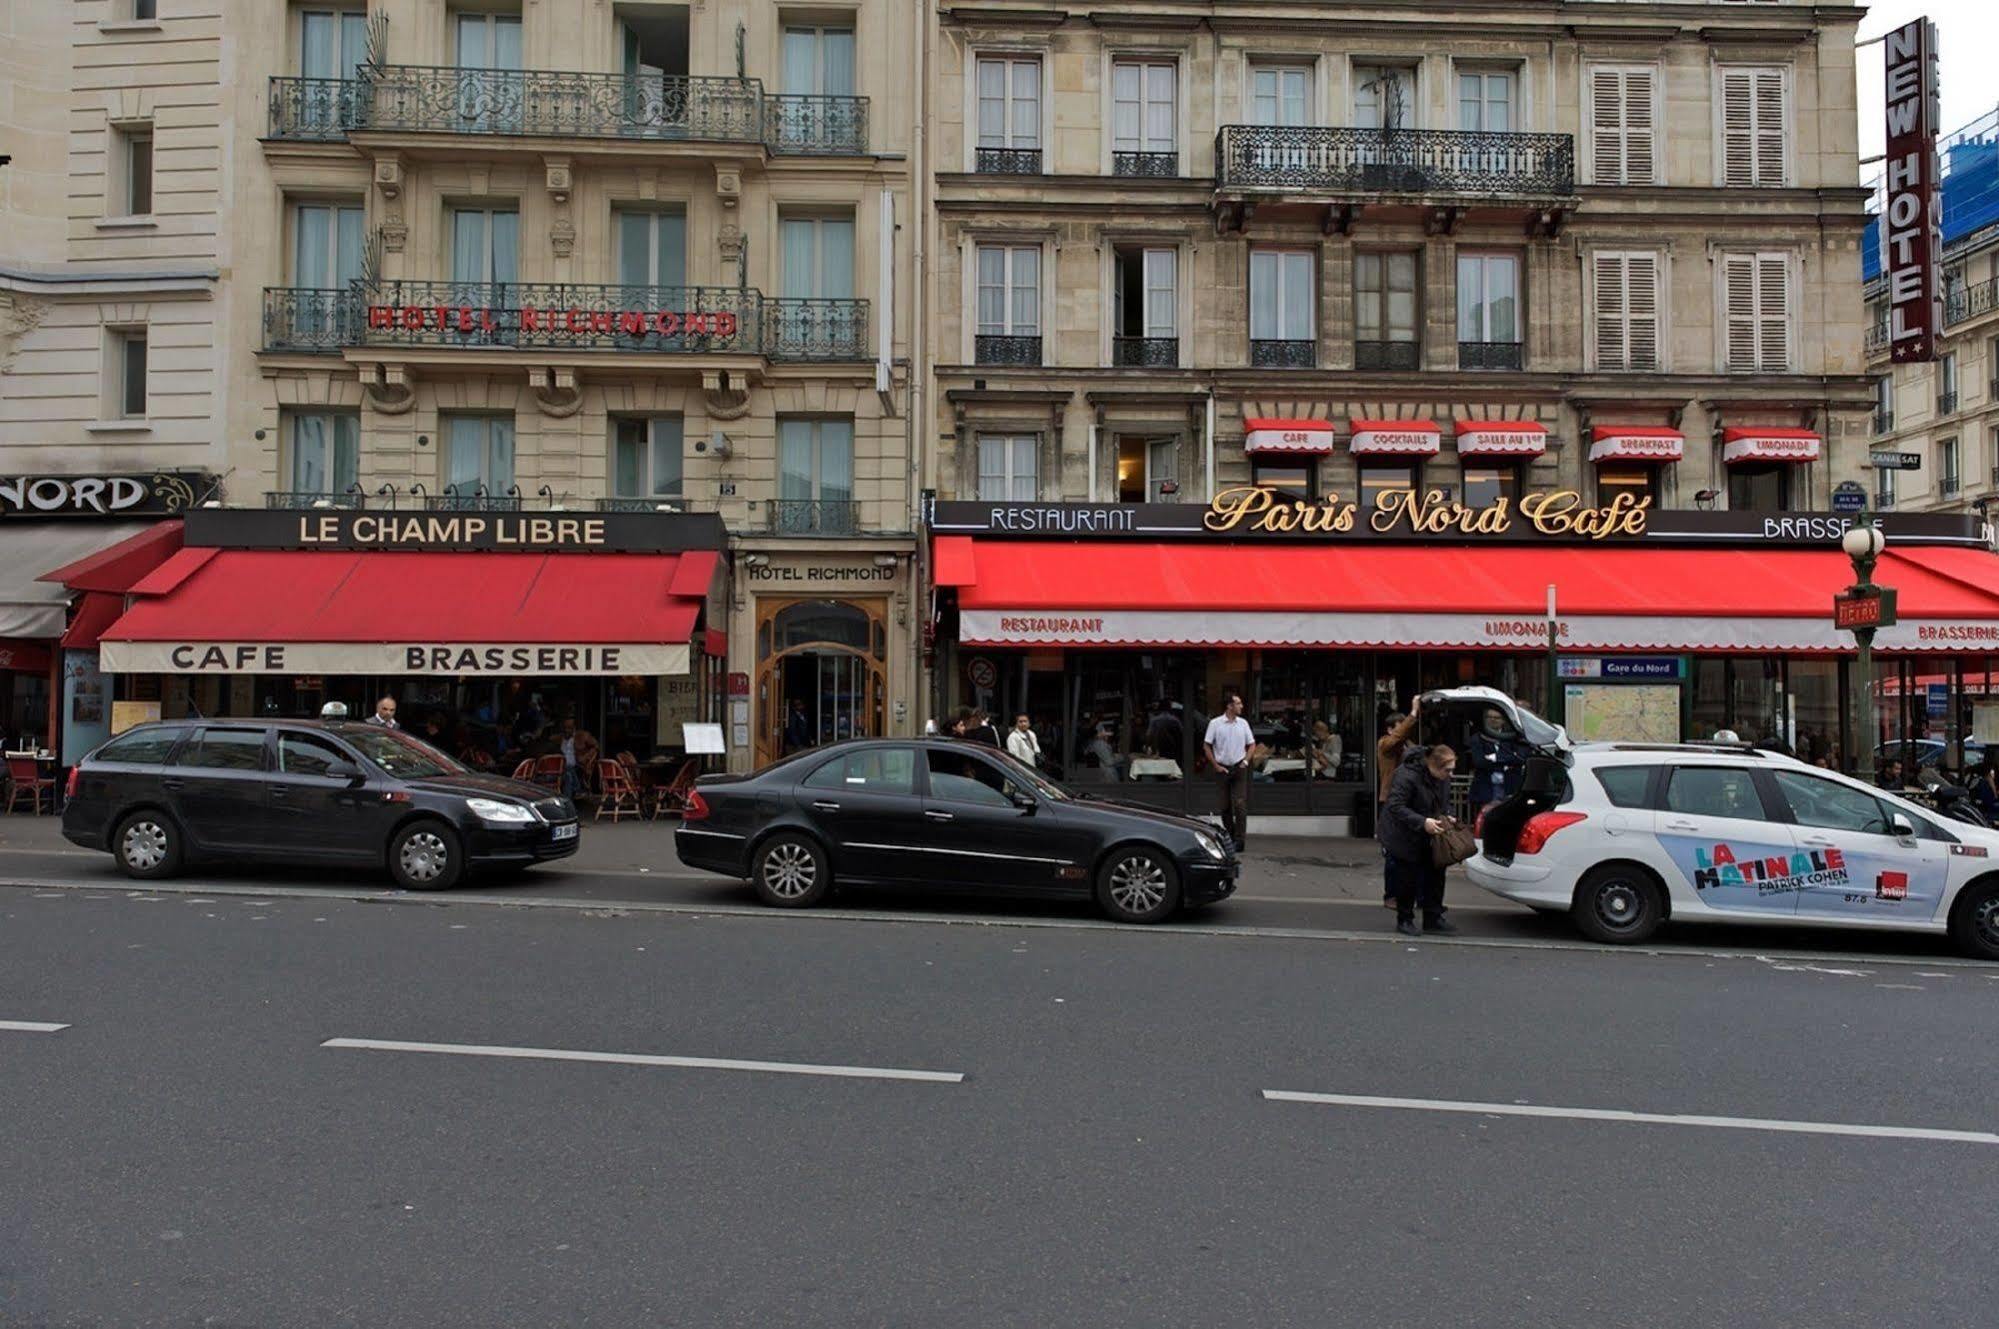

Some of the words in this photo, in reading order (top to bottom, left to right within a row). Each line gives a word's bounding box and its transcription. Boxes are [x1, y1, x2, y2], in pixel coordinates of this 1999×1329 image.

[1887, 24, 1918, 138] NEW
[1889, 152, 1922, 342] HOTEL
[369, 306, 497, 331] HOTEL
[521, 309, 737, 336] RICHMOND
[0, 477, 145, 514] NORD
[991, 508, 1135, 531] RESTAURANT
[1204, 487, 1356, 532] Paris
[1371, 489, 1511, 533] Nord
[1520, 491, 1652, 539] Café
[300, 517, 339, 542] LE
[352, 517, 486, 542] CHAMP
[496, 519, 606, 544] LIBRE
[808, 567, 895, 580] RICHMOND
[1001, 618, 1103, 633] RESTAURANT
[172, 646, 285, 669] CAFE
[407, 647, 620, 671] BRASSERIE
[1607, 664, 1630, 673] Gare
[1632, 664, 1645, 672] du
[1646, 664, 1670, 672] Nord
[1694, 848, 1845, 890] MATINALE
[1695, 843, 1735, 868] LA
[1758, 876, 1804, 891] PATRICK
[1807, 868, 1848, 884] COHEN
